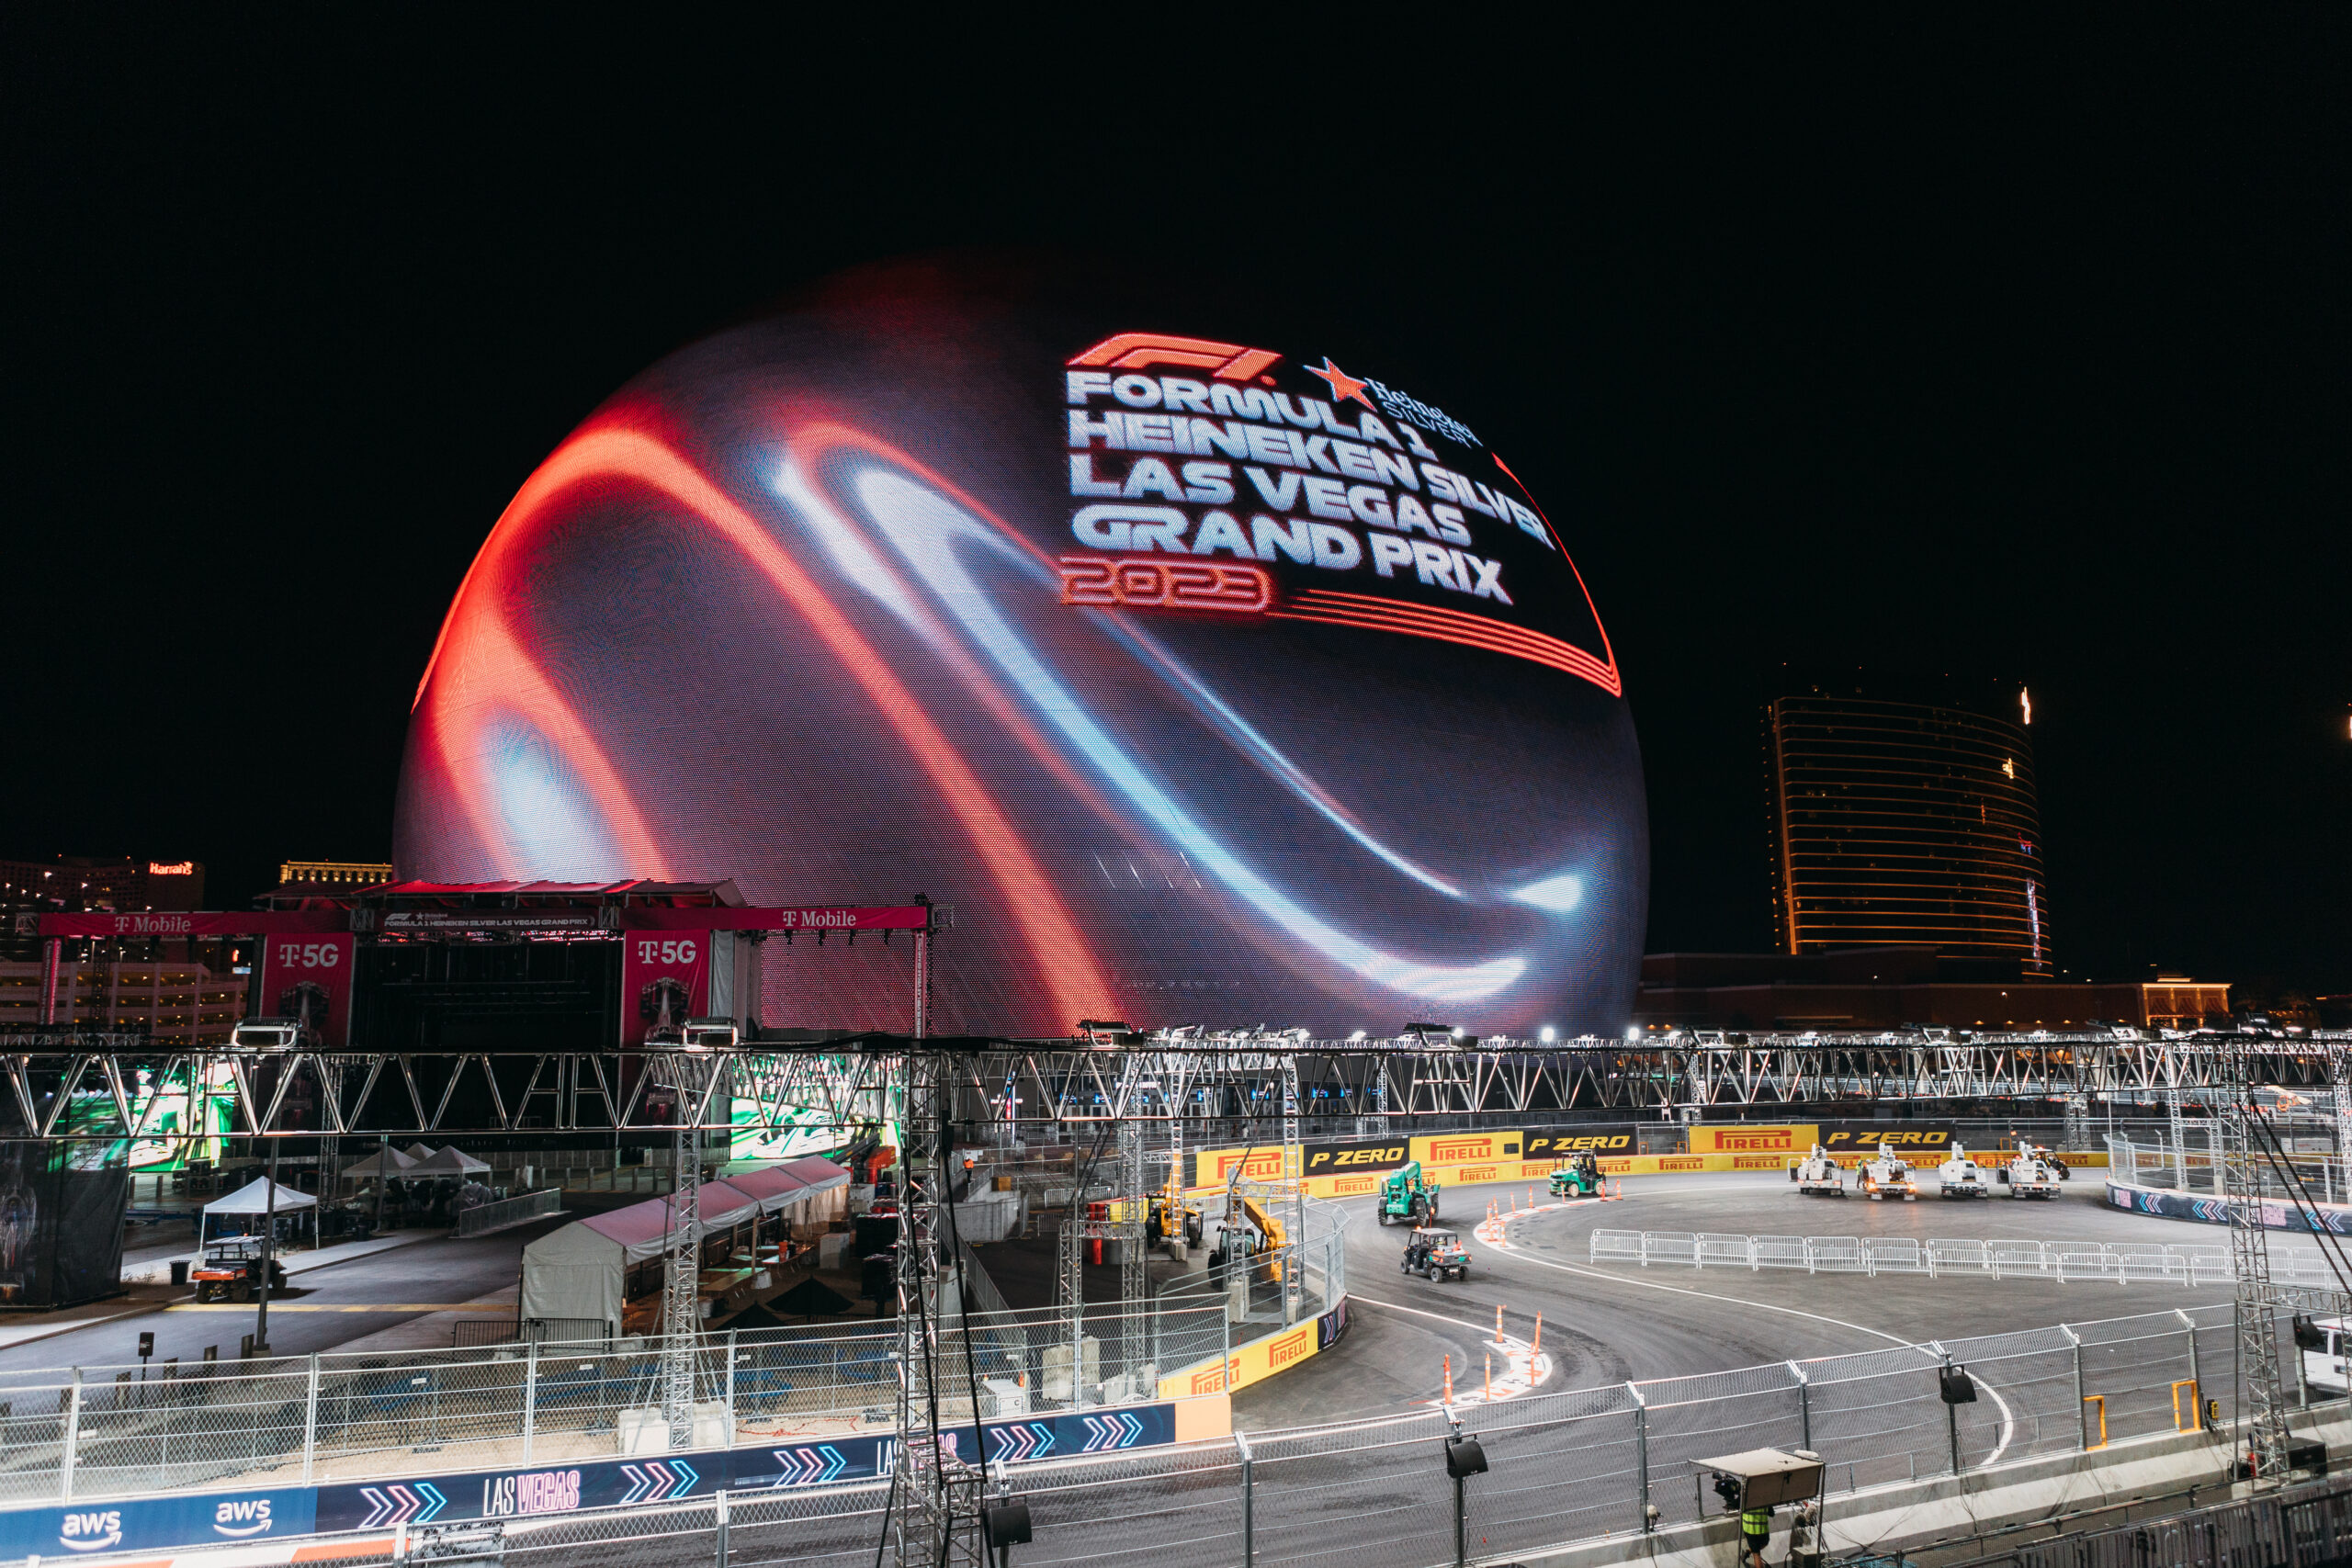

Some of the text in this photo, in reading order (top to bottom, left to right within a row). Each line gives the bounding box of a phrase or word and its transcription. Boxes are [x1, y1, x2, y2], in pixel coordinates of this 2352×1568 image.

[1066, 370, 1439, 462] FORMULA 1
[1382, 400, 1472, 449] SILVER
[1067, 410, 1556, 551] HEINEKEN SILVER
[1069, 454, 1472, 547] LAS VEGAS
[1071, 504, 1513, 605] GRAND PRIX
[1059, 557, 1272, 613] 2023
[133, 917, 191, 932] Mobile
[801, 910, 856, 927] Mobile
[1430, 1138, 1492, 1161] PIRELLI
[1529, 1135, 1631, 1152] P ZERO
[1715, 1130, 1792, 1149] PIRELLI
[1826, 1132, 1948, 1145] P ZERO
[1217, 1152, 1282, 1179] PRELLI
[1309, 1147, 1405, 1168] P ZERO
[1658, 1157, 1703, 1170] PIRELLI
[1734, 1156, 1781, 1168] PIRELLI
[1459, 1167, 1498, 1181] PIRELLI
[1521, 1163, 1562, 1177] PIREL
[1334, 1177, 1374, 1192] PIRELLI
[1269, 1329, 1307, 1368] PIRELLI
[482, 1470, 581, 1517] LAS VEGAS
[215, 1499, 271, 1524] aws
[62, 1510, 121, 1538] aws
